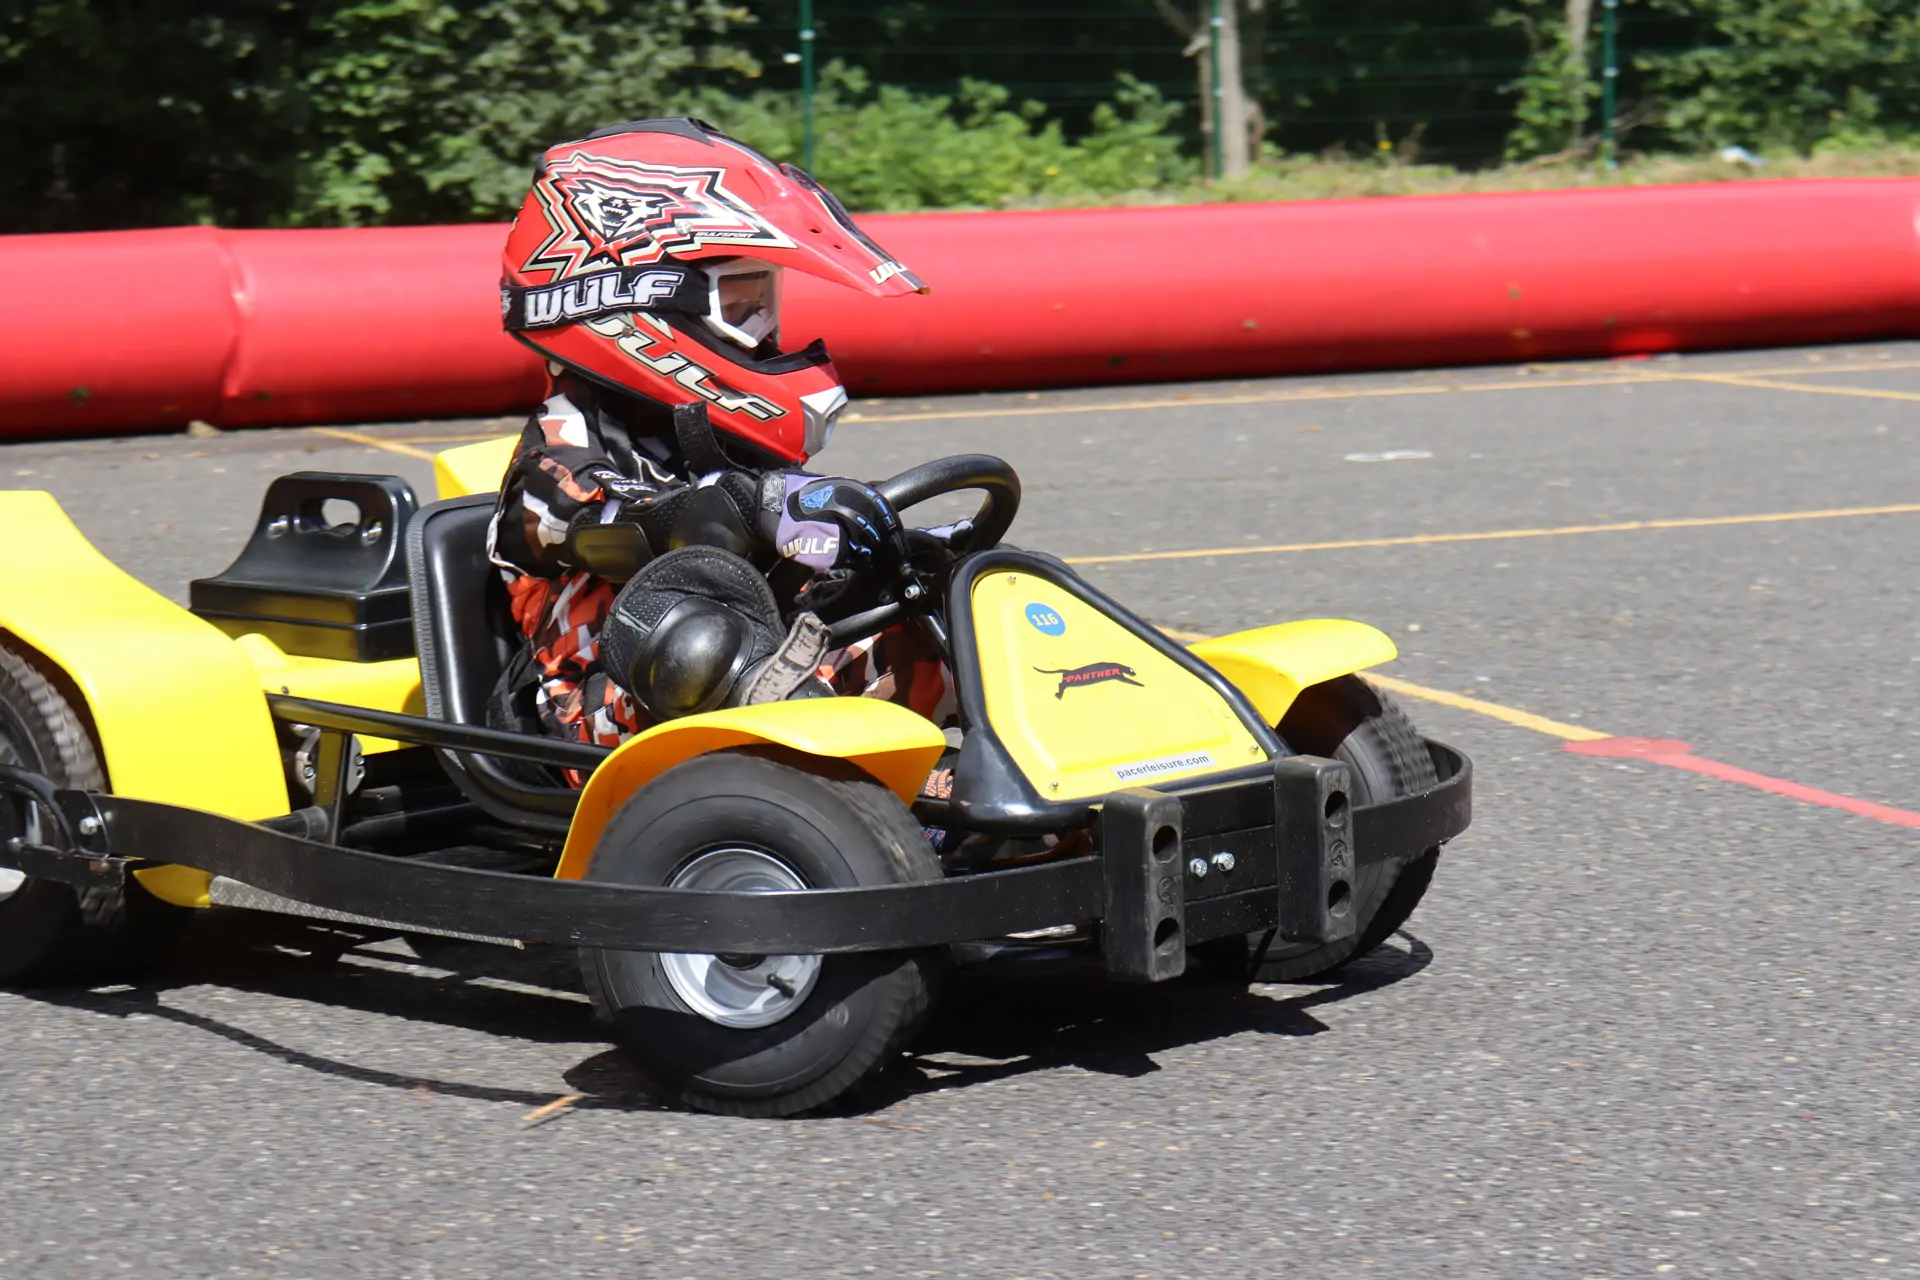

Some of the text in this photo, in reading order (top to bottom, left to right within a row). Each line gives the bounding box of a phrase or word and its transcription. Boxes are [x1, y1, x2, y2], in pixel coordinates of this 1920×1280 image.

[695, 231, 755, 239] WULFSPORT
[525, 270, 685, 326] WULF
[782, 537, 839, 558] WULF
[1031, 613, 1059, 626] 116
[1065, 668, 1121, 682] PANTHER
[1116, 755, 1210, 779] pacerleisure.com
